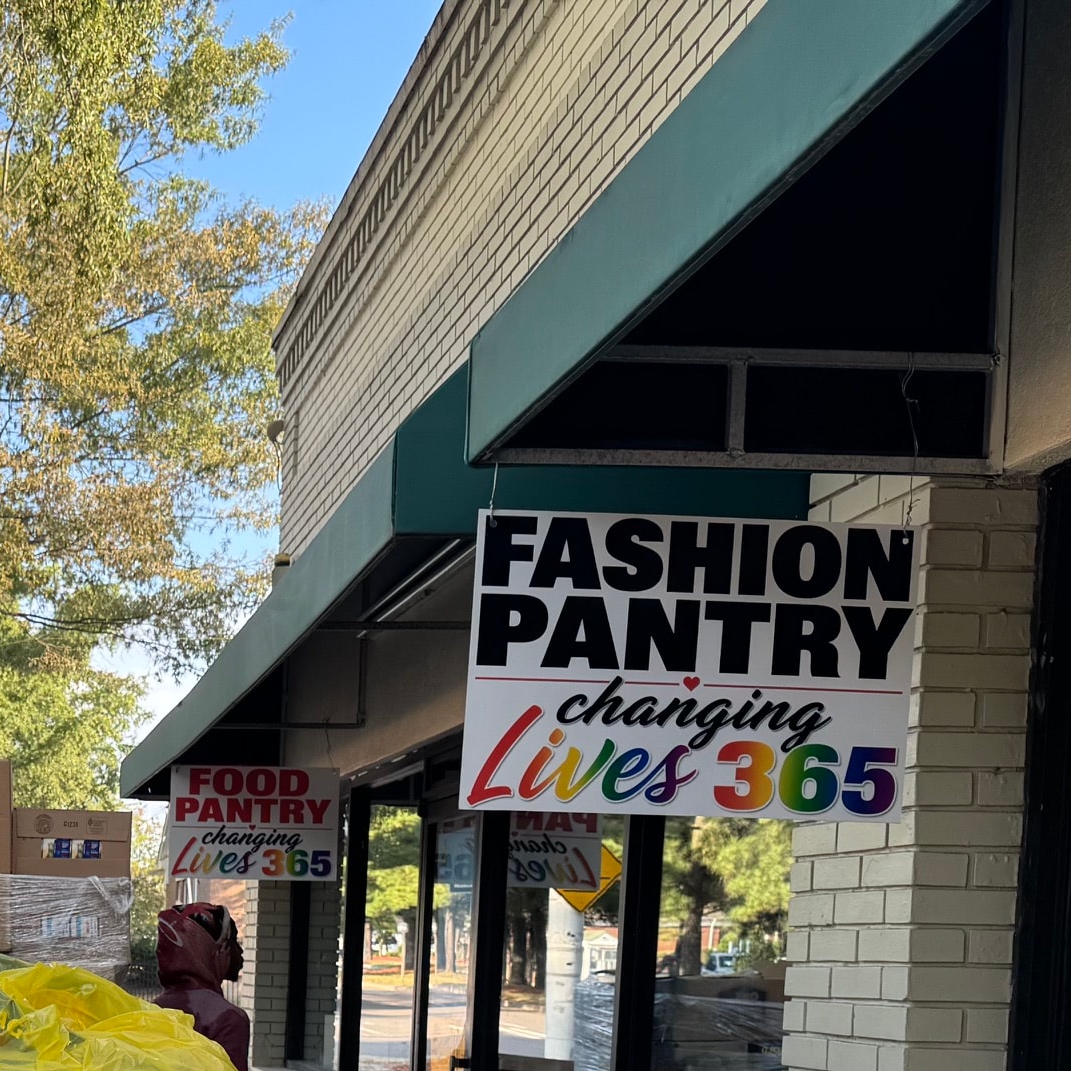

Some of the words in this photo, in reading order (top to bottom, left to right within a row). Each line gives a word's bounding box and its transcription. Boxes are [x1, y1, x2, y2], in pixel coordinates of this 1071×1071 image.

[481, 515, 914, 602] FASHION
[476, 593, 914, 680] PANTRY
[556, 676, 831, 753] changing
[189, 768, 310, 797] FOOD
[466, 704, 698, 806] Lives
[713, 740, 898, 816] 365
[175, 797, 332, 824] PANTRY
[202, 825, 303, 854] changing
[171, 836, 257, 876] Lives
[262, 849, 332, 878] 365
